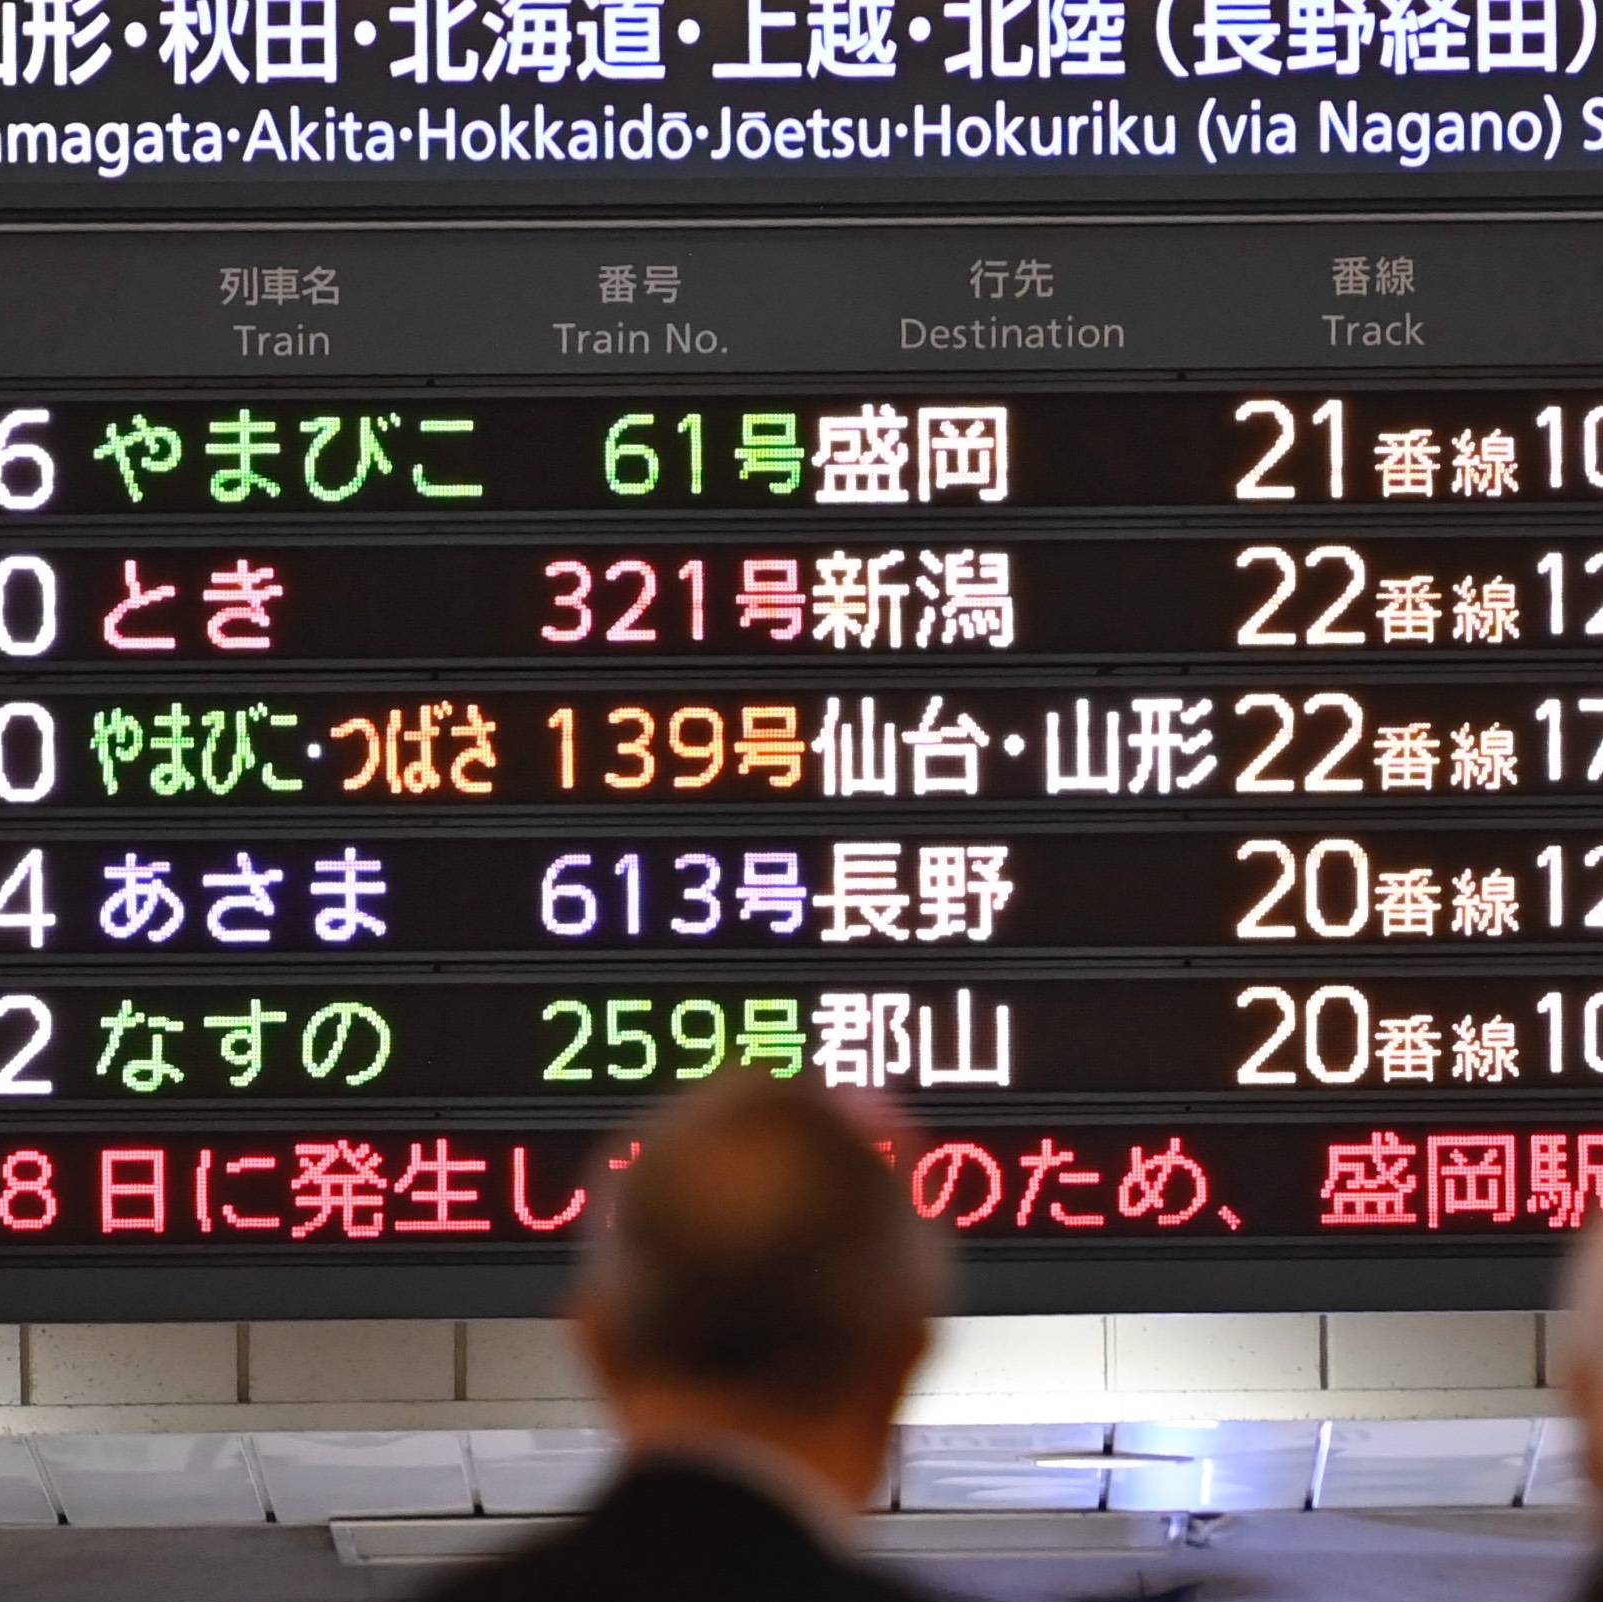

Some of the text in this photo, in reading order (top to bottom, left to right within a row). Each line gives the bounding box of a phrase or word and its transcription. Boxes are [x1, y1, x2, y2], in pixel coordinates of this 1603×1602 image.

[1198, 97, 1297, 164] (via
[1319, 93, 1563, 168] Nagano)
[219, 265, 340, 306] 列車名
[598, 264, 682, 304] 番号
[969, 258, 1054, 299] 行先
[1332, 255, 1415, 296] 番線
[233, 324, 330, 357] Train
[552, 322, 650, 354] Train
[666, 322, 728, 354] No.
[900, 315, 1125, 349] Destination
[1321, 313, 1425, 346] Track
[93, 409, 483, 503] やまびこ
[604, 412, 805, 495] 61号
[810, 403, 1009, 504] 盛岡
[1234, 399, 1520, 500] 21番線
[103, 558, 284, 650] とき
[540, 558, 807, 643] 321号
[811, 548, 1015, 650] 新潟
[1235, 545, 1521, 646] 22番線
[547, 705, 807, 790] 139号
[810, 695, 1218, 797] 仙台・山形
[1234, 692, 1519, 793] 22番線
[99, 847, 387, 944] あさま
[541, 851, 808, 937] 613号
[811, 841, 1014, 943] 長野
[1235, 838, 1520, 939] 20番線
[95, 998, 391, 1092] なすの
[542, 998, 807, 1081] 259号
[811, 987, 1011, 1088] 郡山
[1236, 984, 1520, 1085] 20番線
